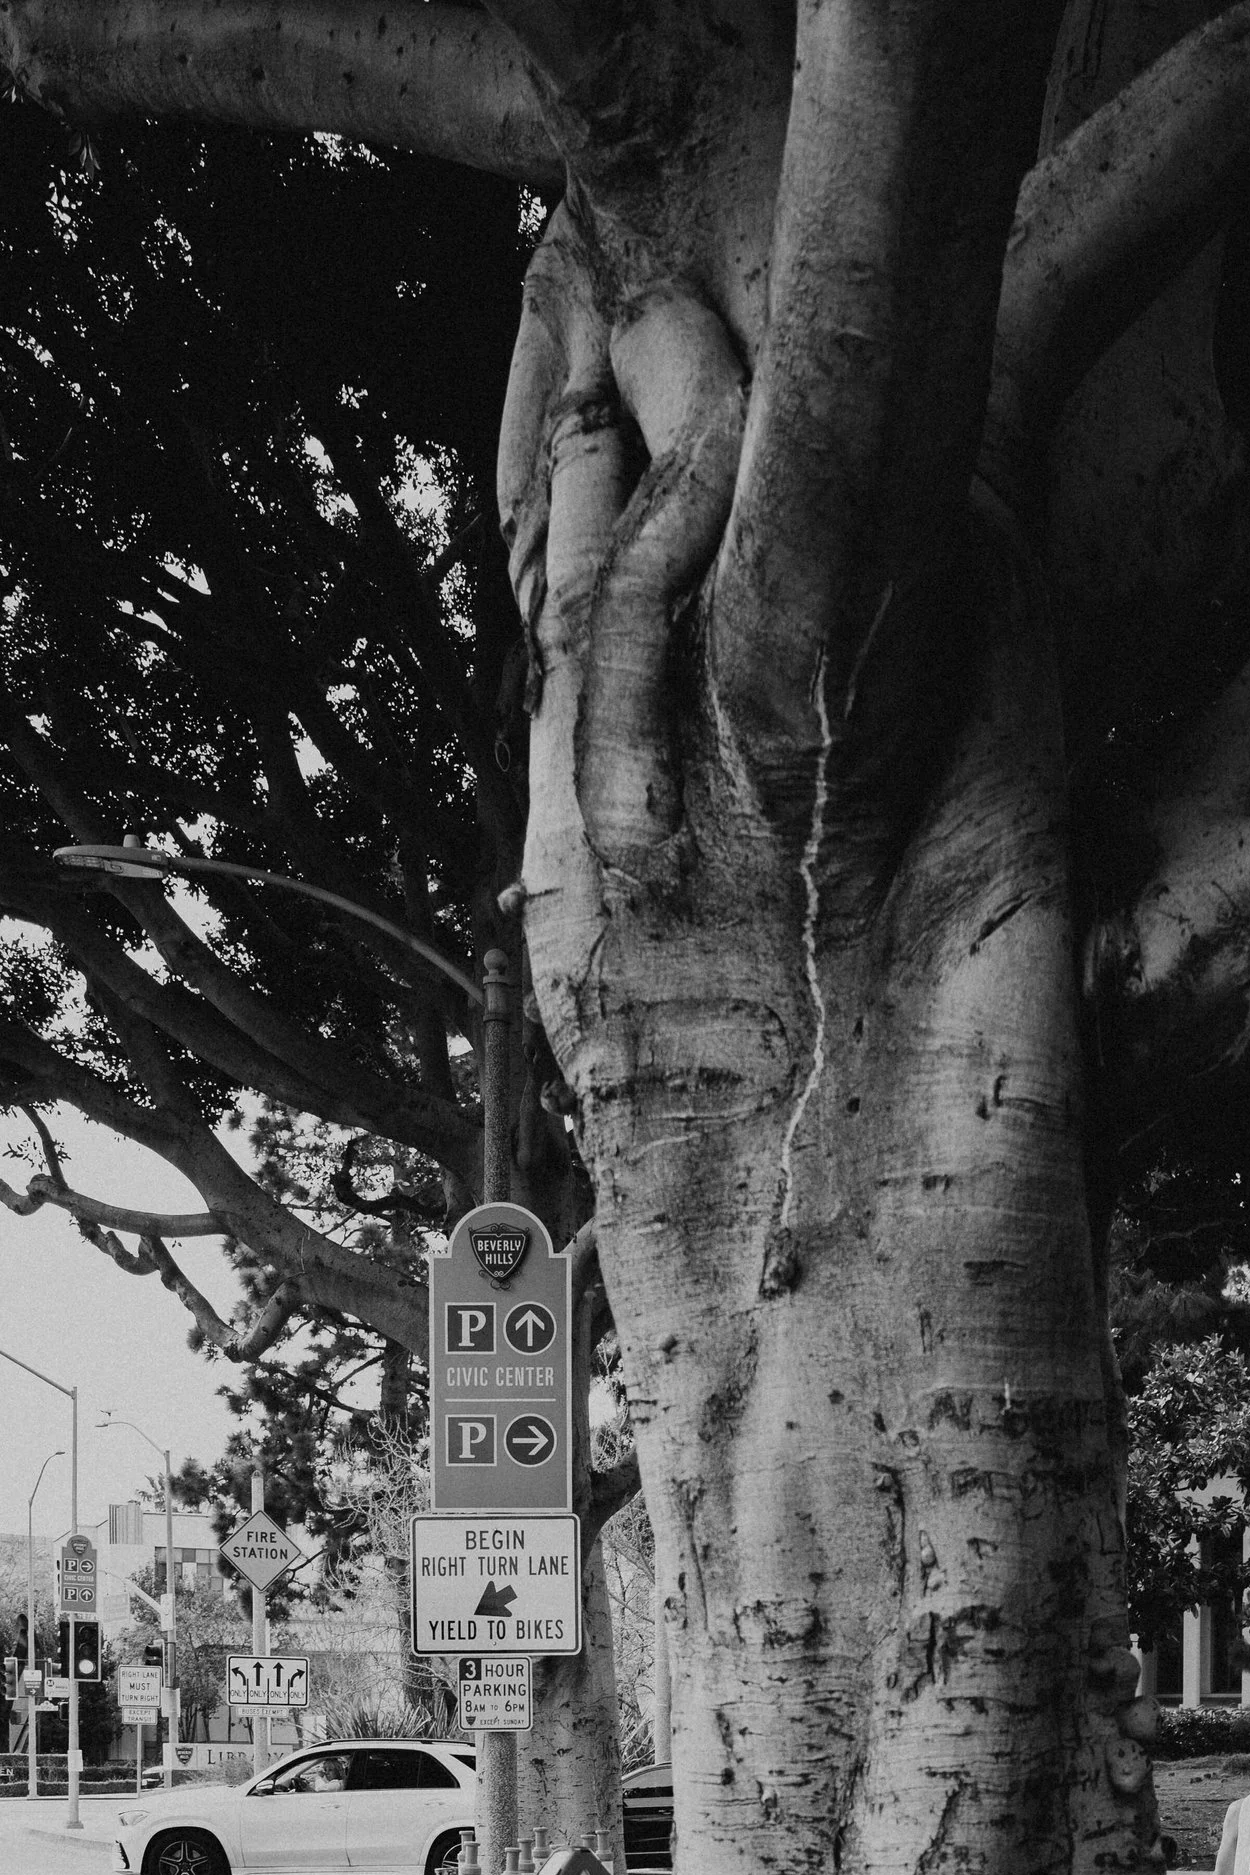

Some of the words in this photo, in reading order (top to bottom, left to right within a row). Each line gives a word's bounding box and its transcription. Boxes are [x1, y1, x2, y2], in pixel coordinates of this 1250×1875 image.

[477, 1240, 521, 1251] BEVERLY
[485, 1253, 513, 1265] HILLS
[457, 1310, 487, 1347] P
[446, 1366, 489, 1387] CIVIC
[495, 1366, 554, 1387] CENTER
[457, 1422, 487, 1459] P
[247, 1531, 277, 1544] FIRE
[465, 1529, 525, 1550] BEGIN
[233, 1547, 288, 1560] STATION
[421, 1556, 466, 1576] RIGHT
[478, 1556, 518, 1576] TURN
[529, 1555, 569, 1576] LANE
[429, 1620, 477, 1640] YIELD
[487, 1620, 506, 1640] TO
[516, 1619, 564, 1639] BIKES
[122, 1670, 141, 1678] RIGHT
[142, 1670, 158, 1679] LANE
[465, 1660, 477, 1679] 3
[485, 1663, 524, 1677] HOUR
[130, 1682, 151, 1691] MUST
[463, 1683, 526, 1697] PARKING
[122, 1694, 138, 1702] TURN
[140, 1694, 159, 1702] RIGHT
[230, 1689, 247, 1698] ONLY
[249, 1689, 267, 1698] ONLY
[270, 1690, 288, 1698] ONLY
[289, 1691, 305, 1699] ONLY
[465, 1700, 486, 1713] 8AM
[505, 1700, 525, 1712] 6PM
[480, 1718, 500, 1726] EXCEPT
[503, 1718, 525, 1726] SUNDAY
